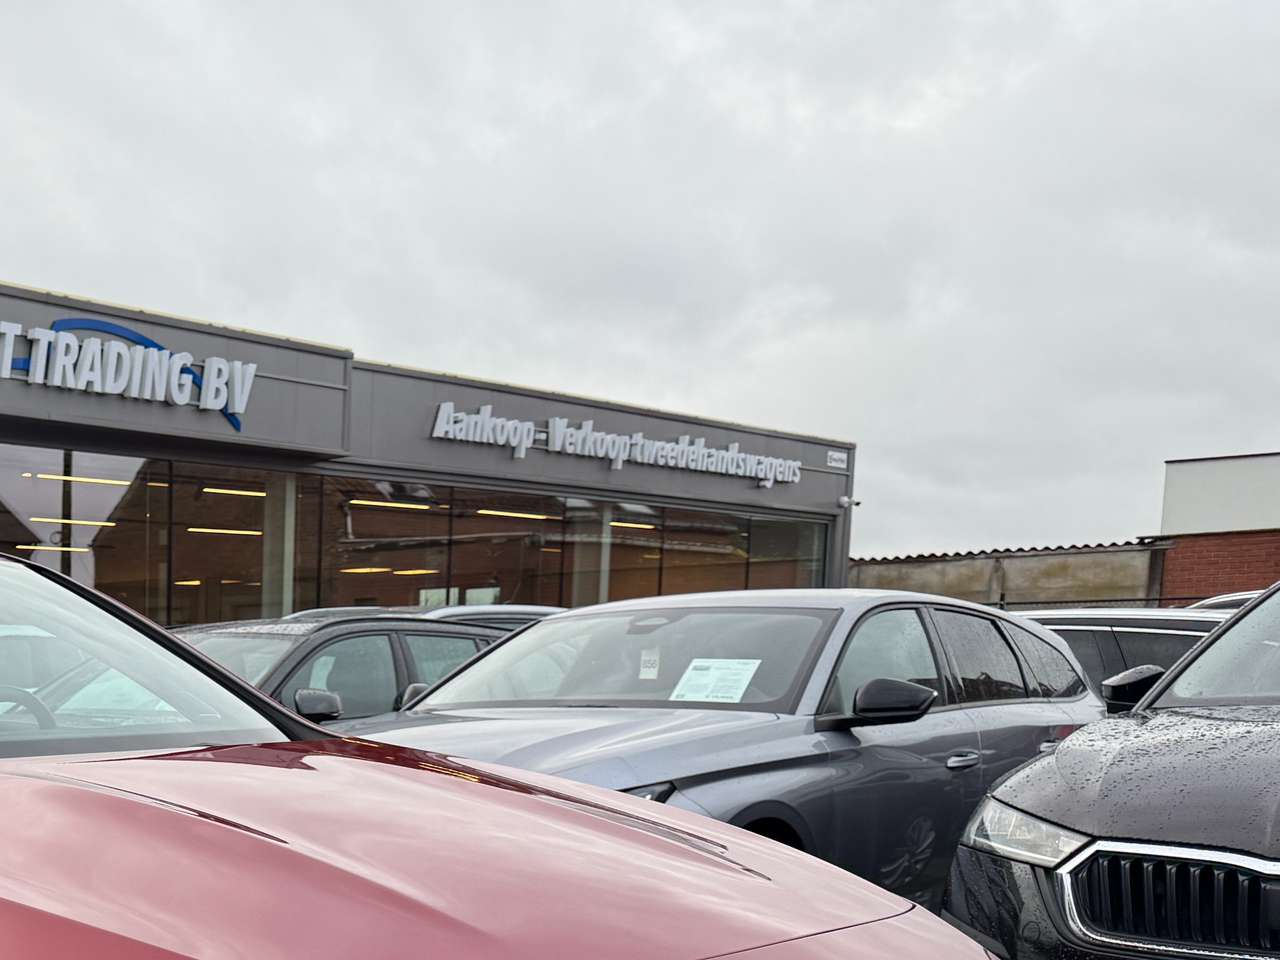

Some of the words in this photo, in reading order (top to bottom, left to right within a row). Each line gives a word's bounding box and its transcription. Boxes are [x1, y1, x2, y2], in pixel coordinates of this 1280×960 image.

[28, 327, 194, 406] TRADING
[199, 357, 256, 414] BV
[432, 402, 535, 459] Aankoop
[548, 417, 630, 470] Verkoop
[630, 432, 801, 488] tweedehandswagens
